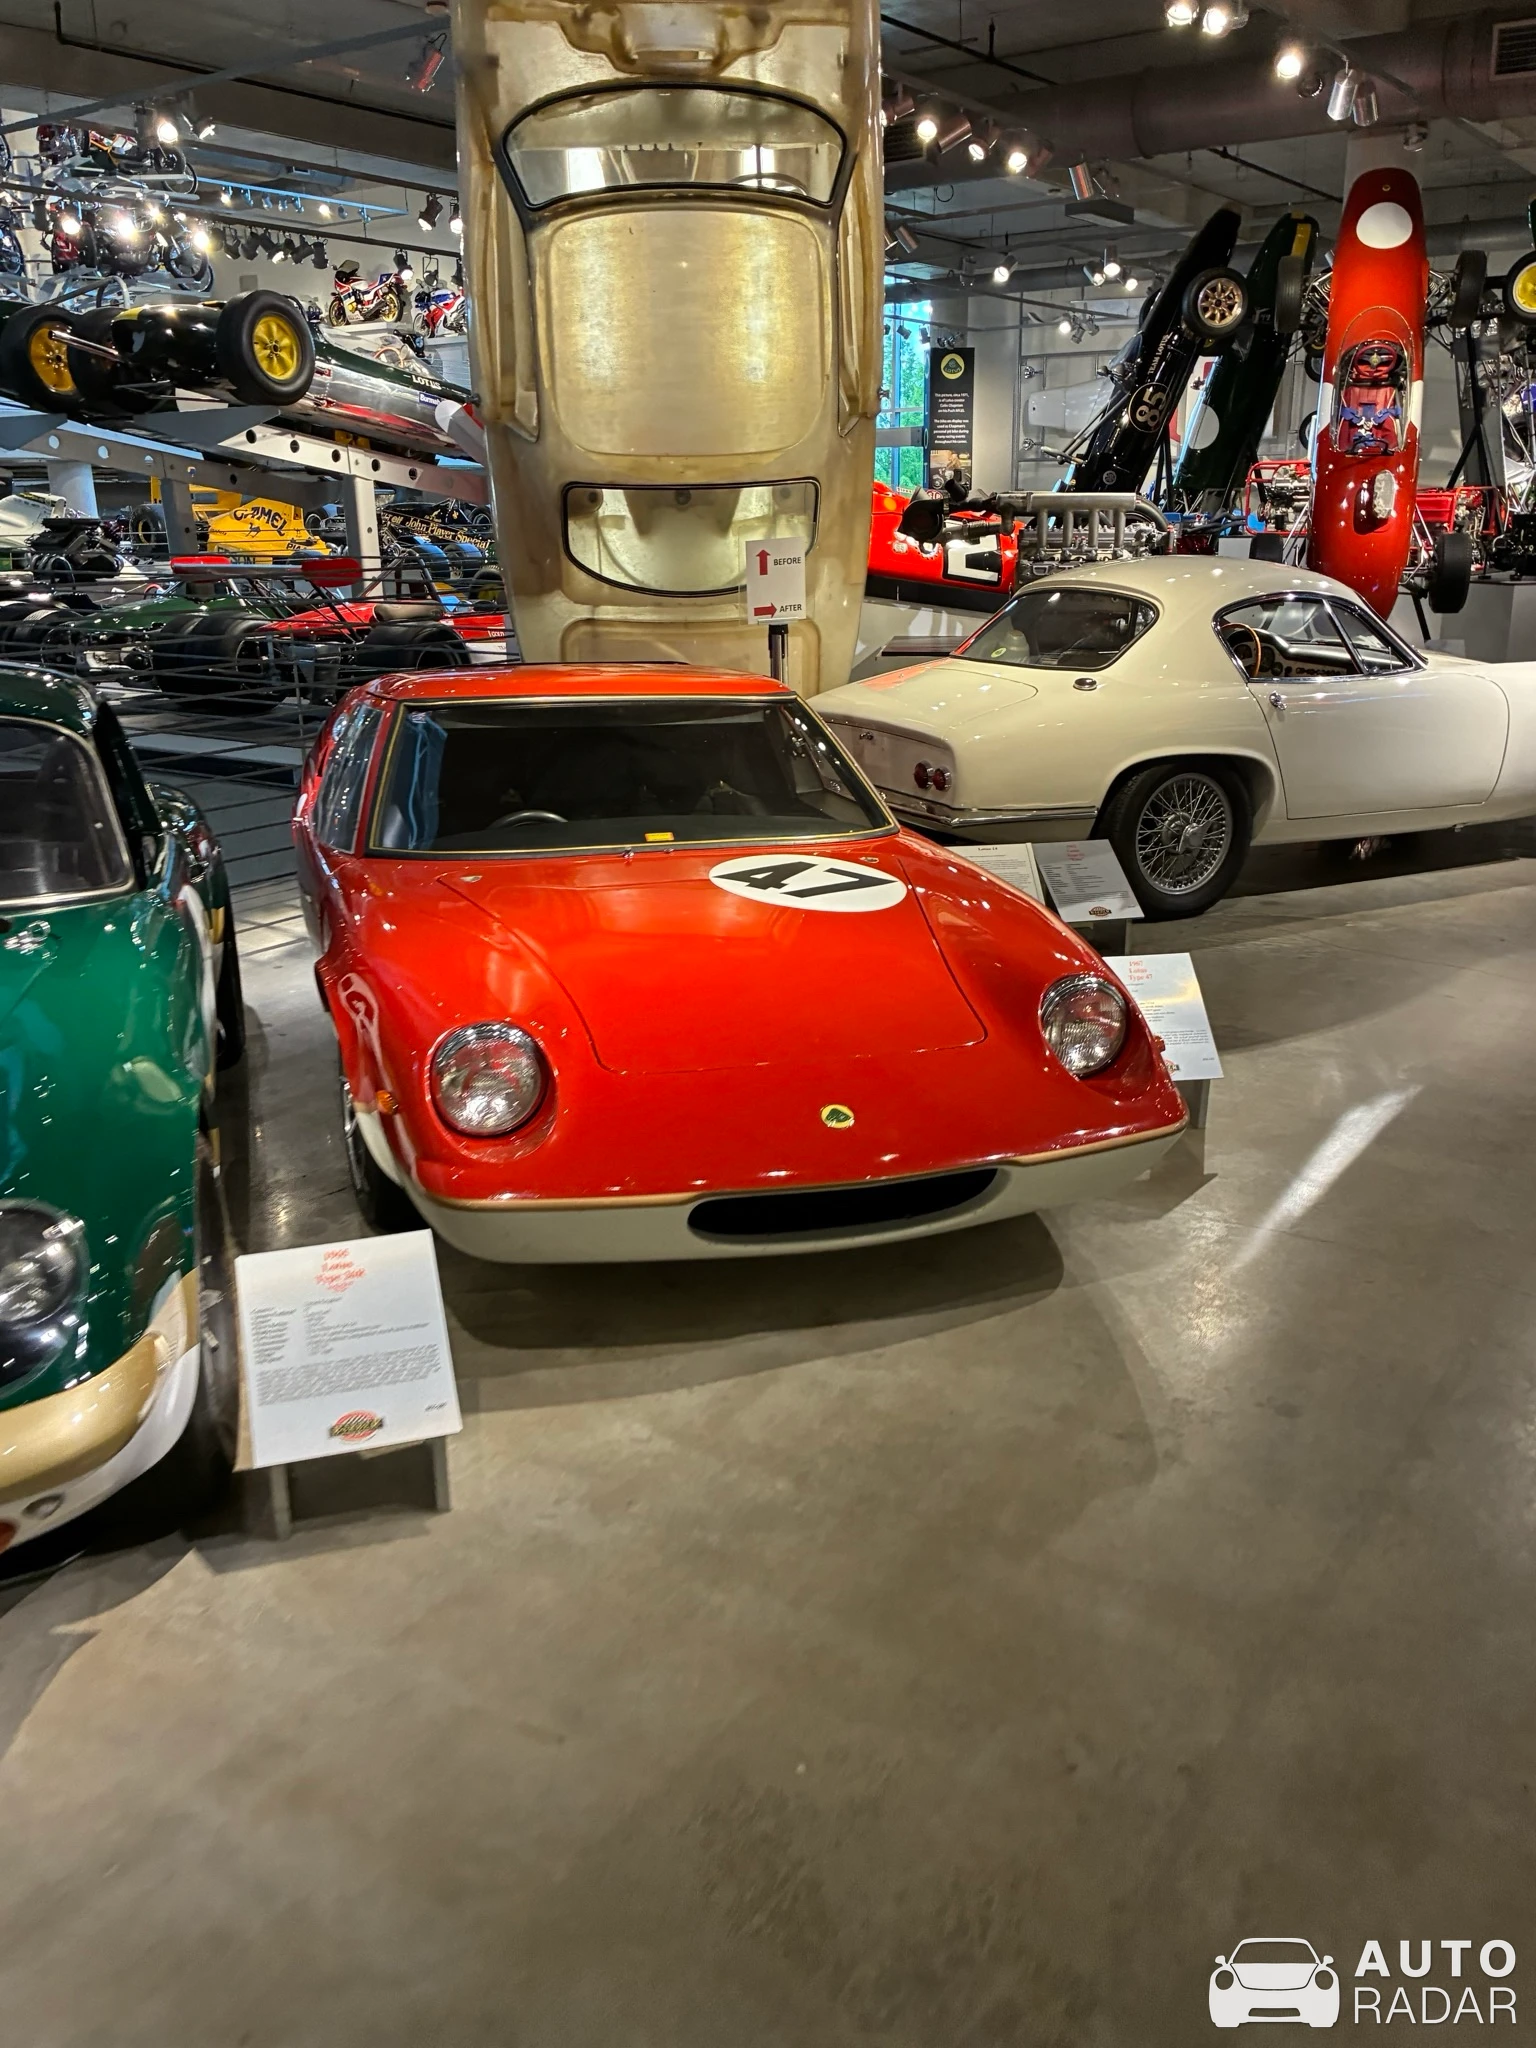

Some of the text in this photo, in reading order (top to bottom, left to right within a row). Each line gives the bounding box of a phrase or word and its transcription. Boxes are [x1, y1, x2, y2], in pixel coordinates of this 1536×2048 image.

[1147, 356, 1161, 375] TEAM
[411, 374, 442, 390] LOTUS
[1135, 387, 1167, 427] 85
[233, 506, 288, 536] CAMEL
[405, 517, 427, 534] John
[428, 521, 453, 540] Player
[455, 531, 491, 549] Special
[773, 556, 802, 566] BEFORE
[779, 603, 803, 613] AFTER
[712, 861, 899, 898] 47
